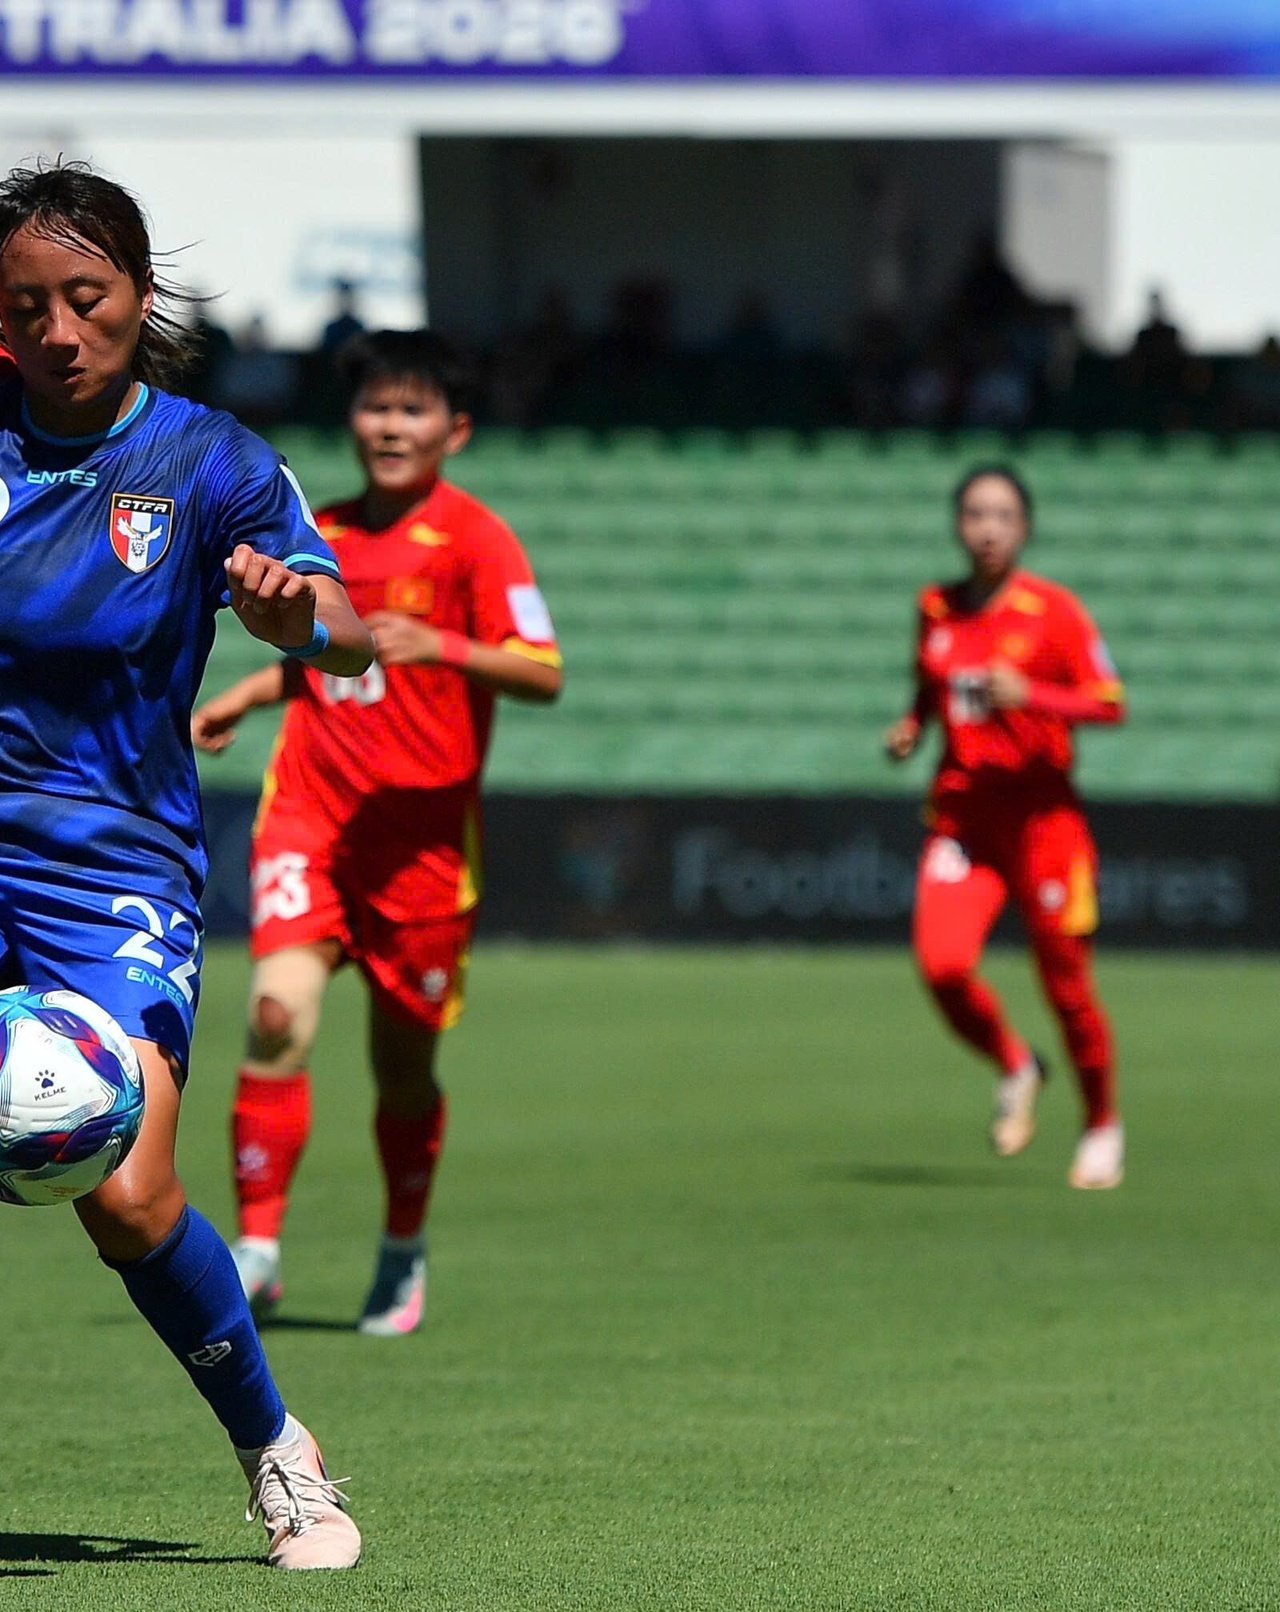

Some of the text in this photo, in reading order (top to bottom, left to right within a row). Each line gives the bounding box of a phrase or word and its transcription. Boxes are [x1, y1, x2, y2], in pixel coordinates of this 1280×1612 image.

[364, 0, 625, 66] 2026
[26, 468, 98, 488] ENTES
[117, 499, 169, 514] CTFA
[111, 895, 200, 1005] 22
[125, 965, 185, 1009] ENTES
[33, 1086, 67, 1101] KELME
